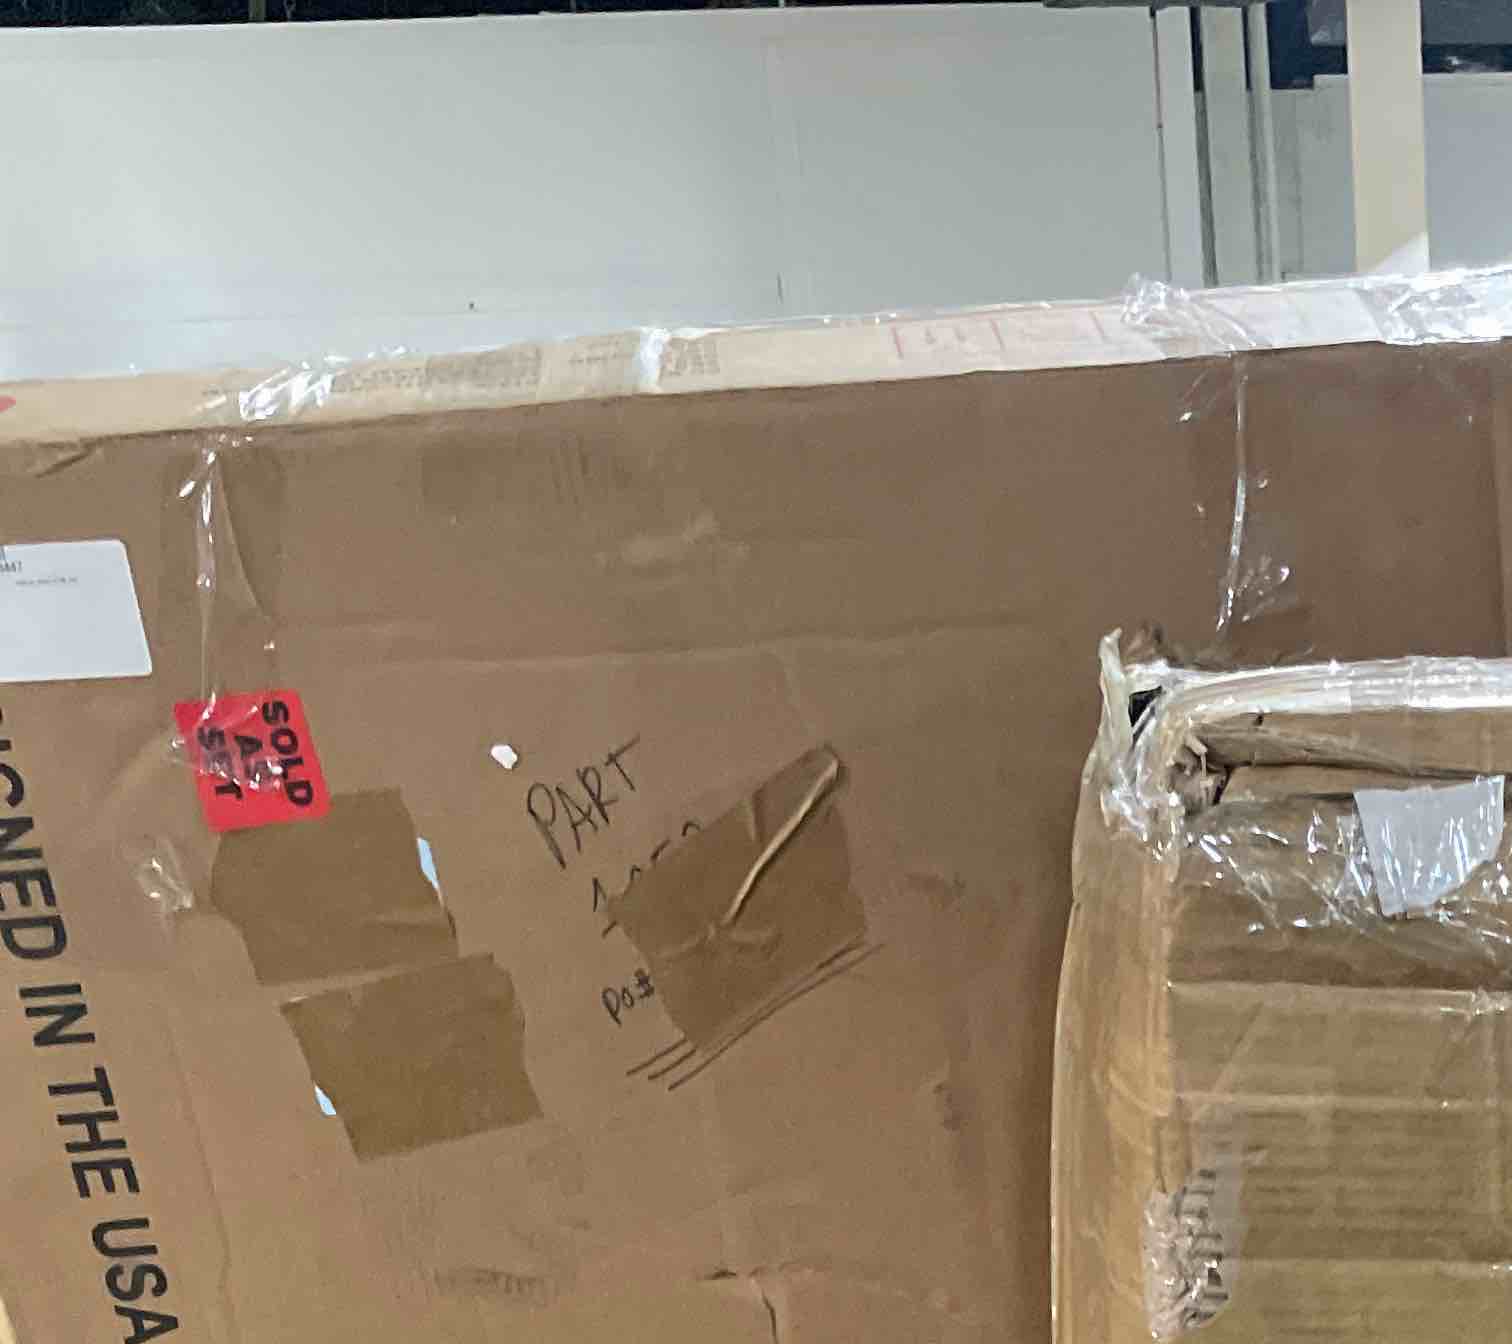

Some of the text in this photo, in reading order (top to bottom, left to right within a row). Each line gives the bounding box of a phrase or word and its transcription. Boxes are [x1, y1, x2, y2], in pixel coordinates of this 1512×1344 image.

[262, 701, 313, 806] SOLD
[527, 734, 640, 869] PART
[19, 984, 96, 1047] IN
[47, 1068, 141, 1199] THE
